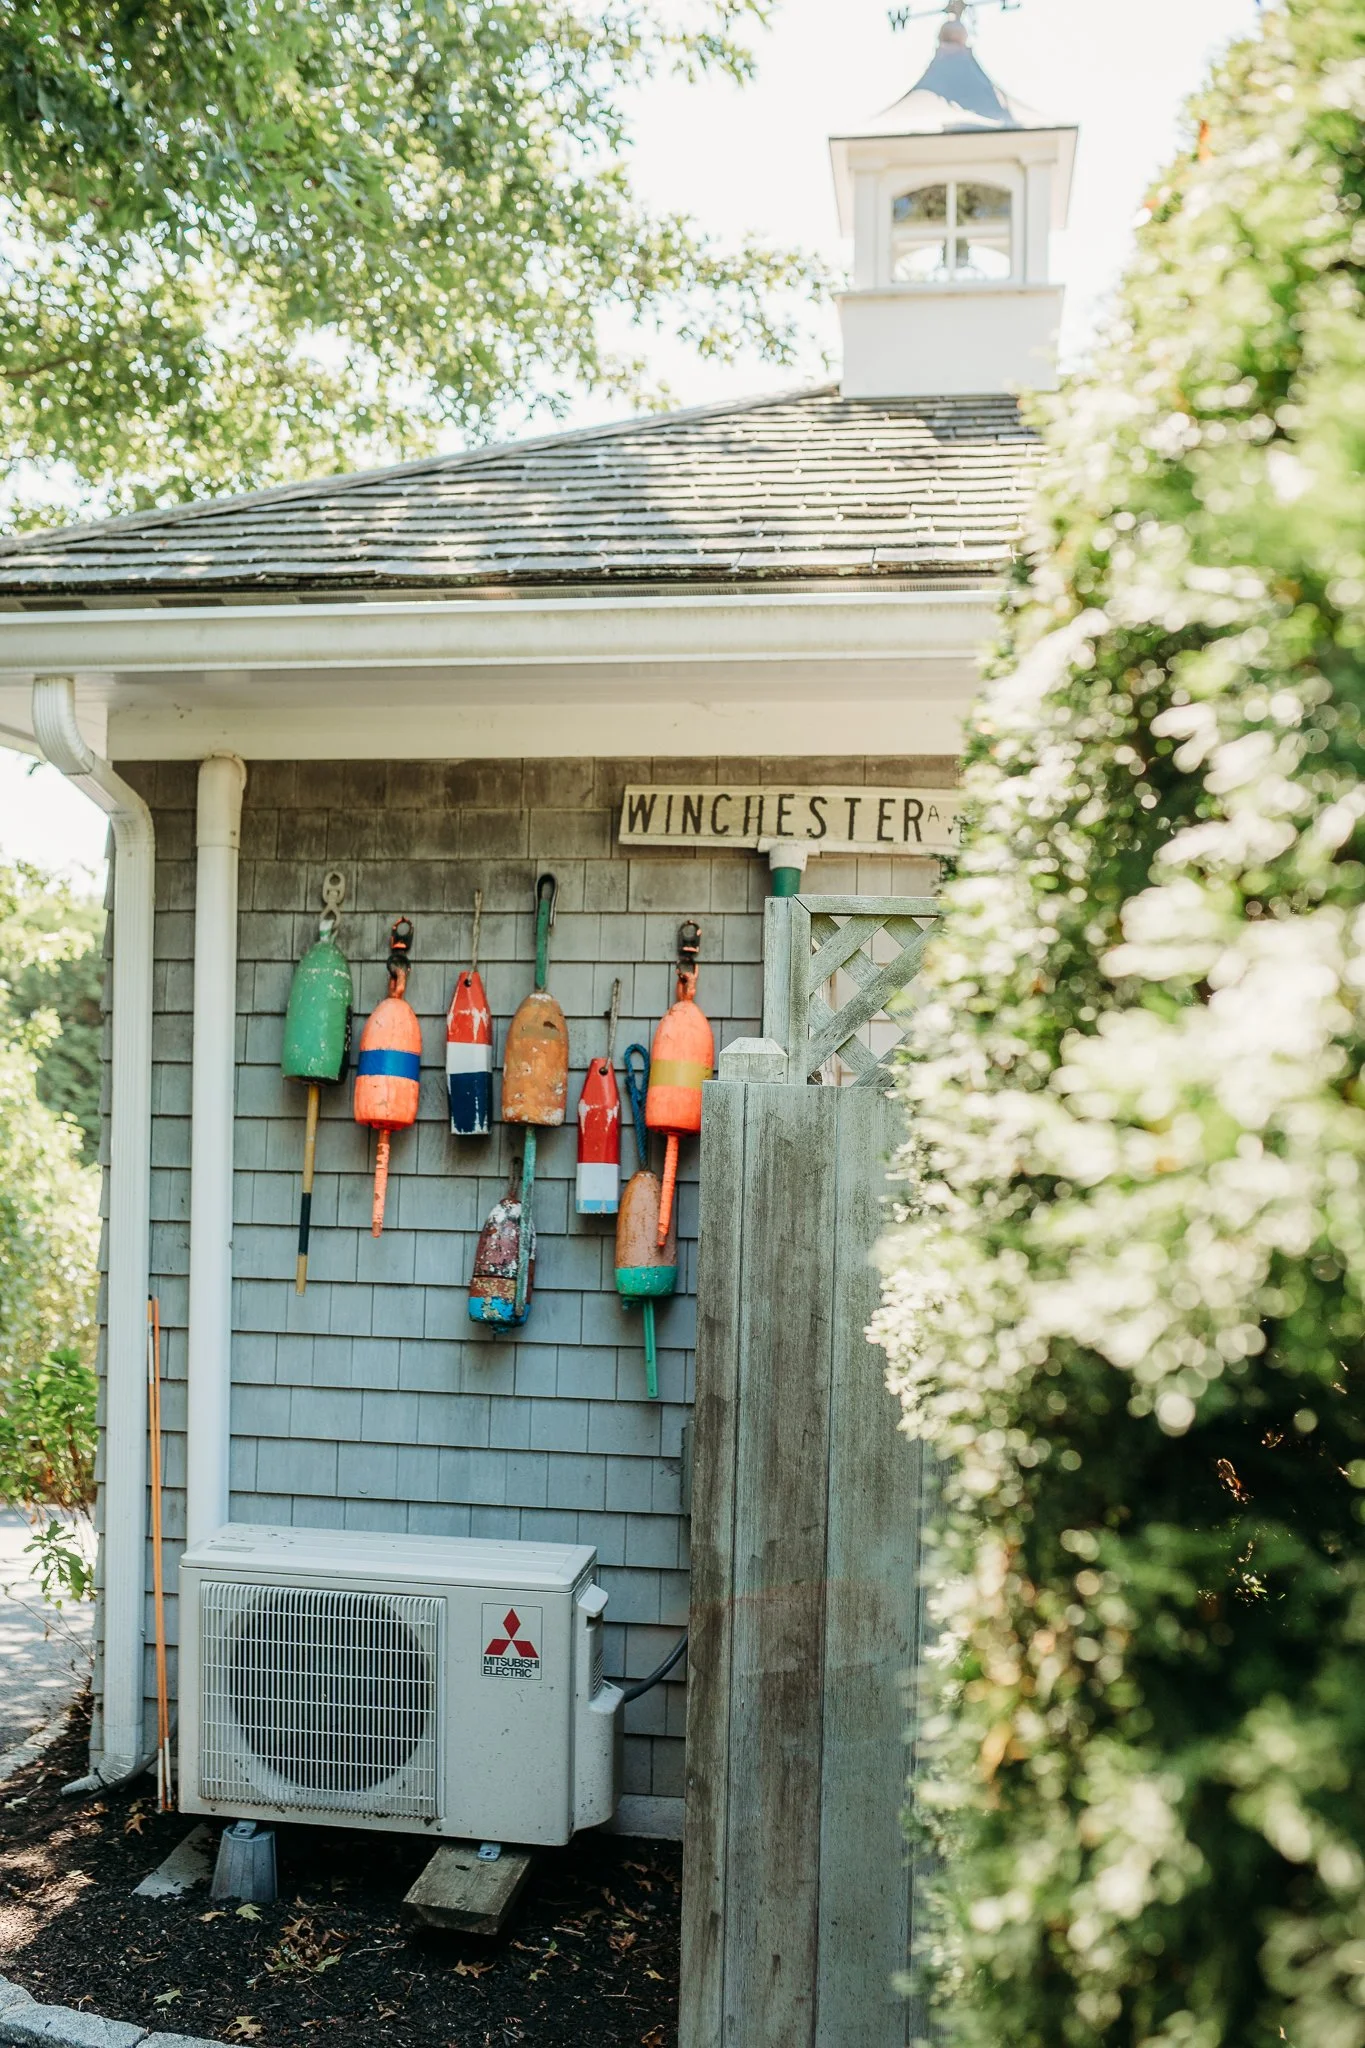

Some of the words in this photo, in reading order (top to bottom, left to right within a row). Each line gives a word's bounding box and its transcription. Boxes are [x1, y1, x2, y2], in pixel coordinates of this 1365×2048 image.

[888, 7, 910, 32] W
[628, 793, 923, 843] WINCHESTER
[483, 1656, 540, 1669] MITSUBISHI
[483, 1666, 532, 1678] ELECTRIC
